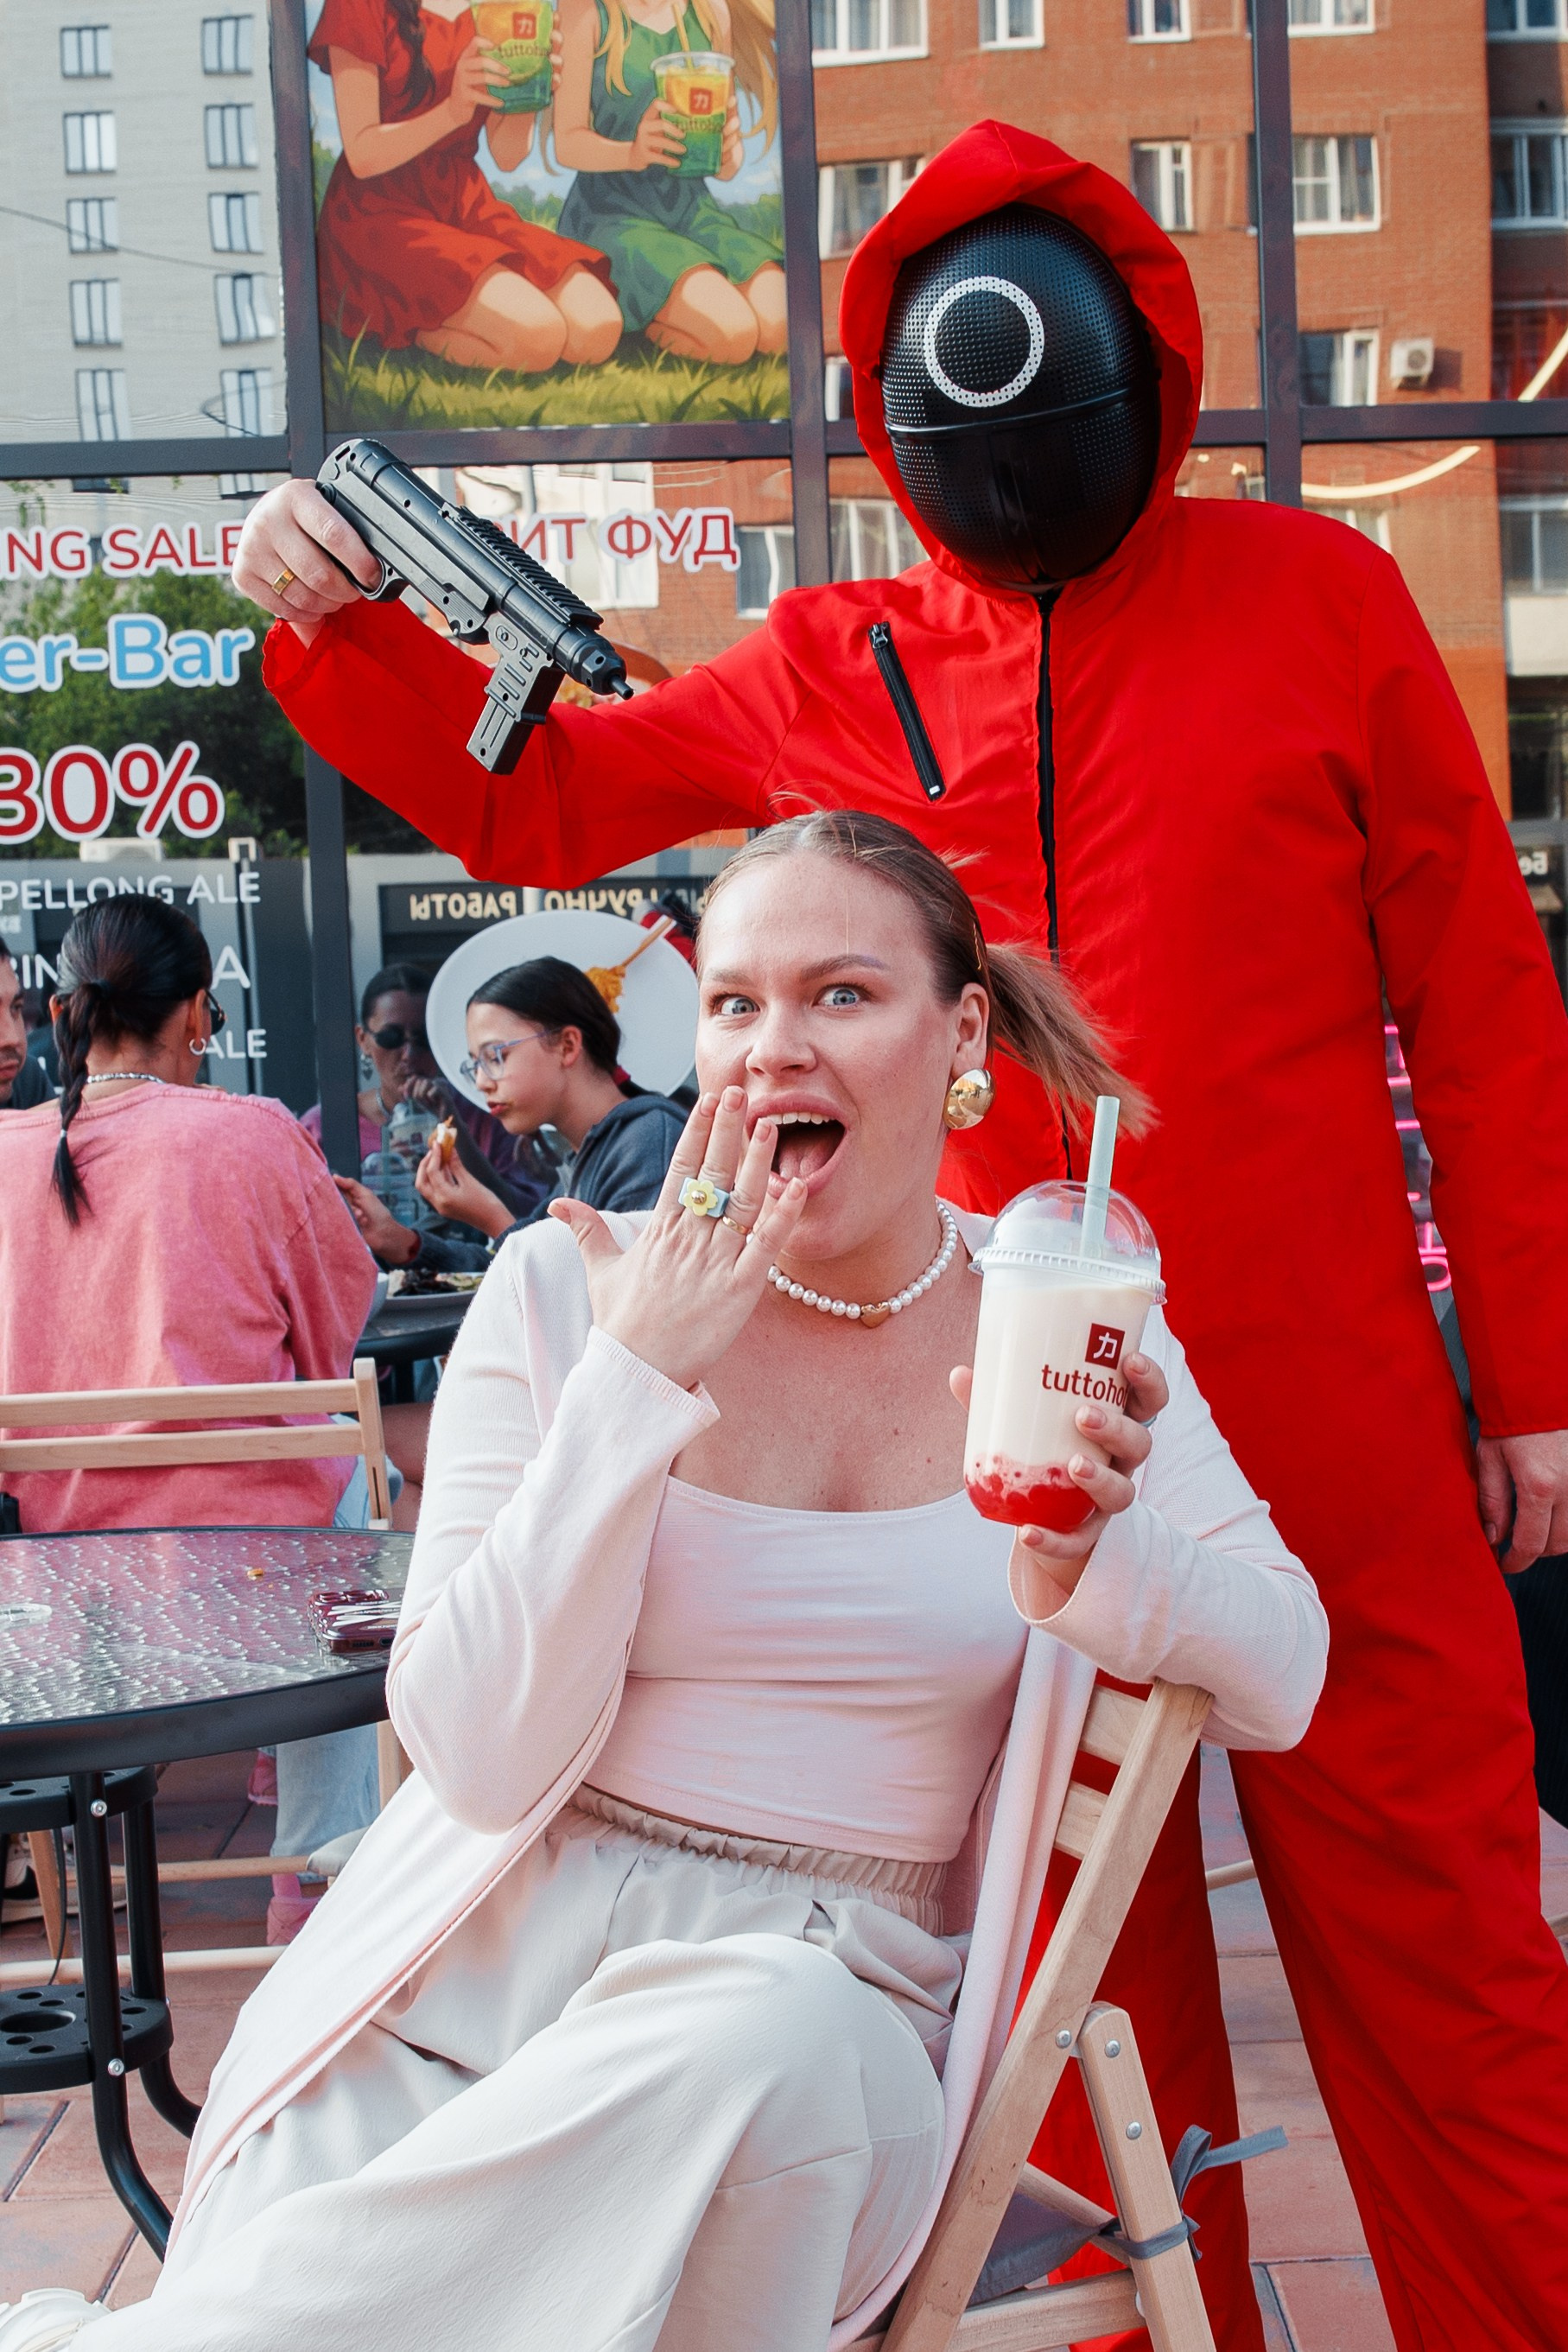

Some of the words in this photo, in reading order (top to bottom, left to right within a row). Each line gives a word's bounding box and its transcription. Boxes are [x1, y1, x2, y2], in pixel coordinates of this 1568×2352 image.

[108, 525, 245, 569] SALE
[494, 518, 587, 561] ИТ
[607, 514, 737, 565] ФУД
[0, 617, 250, 686] er-Bar
[187, 871, 262, 906] ALE
[1041, 1364, 1130, 1410] tuttoho
